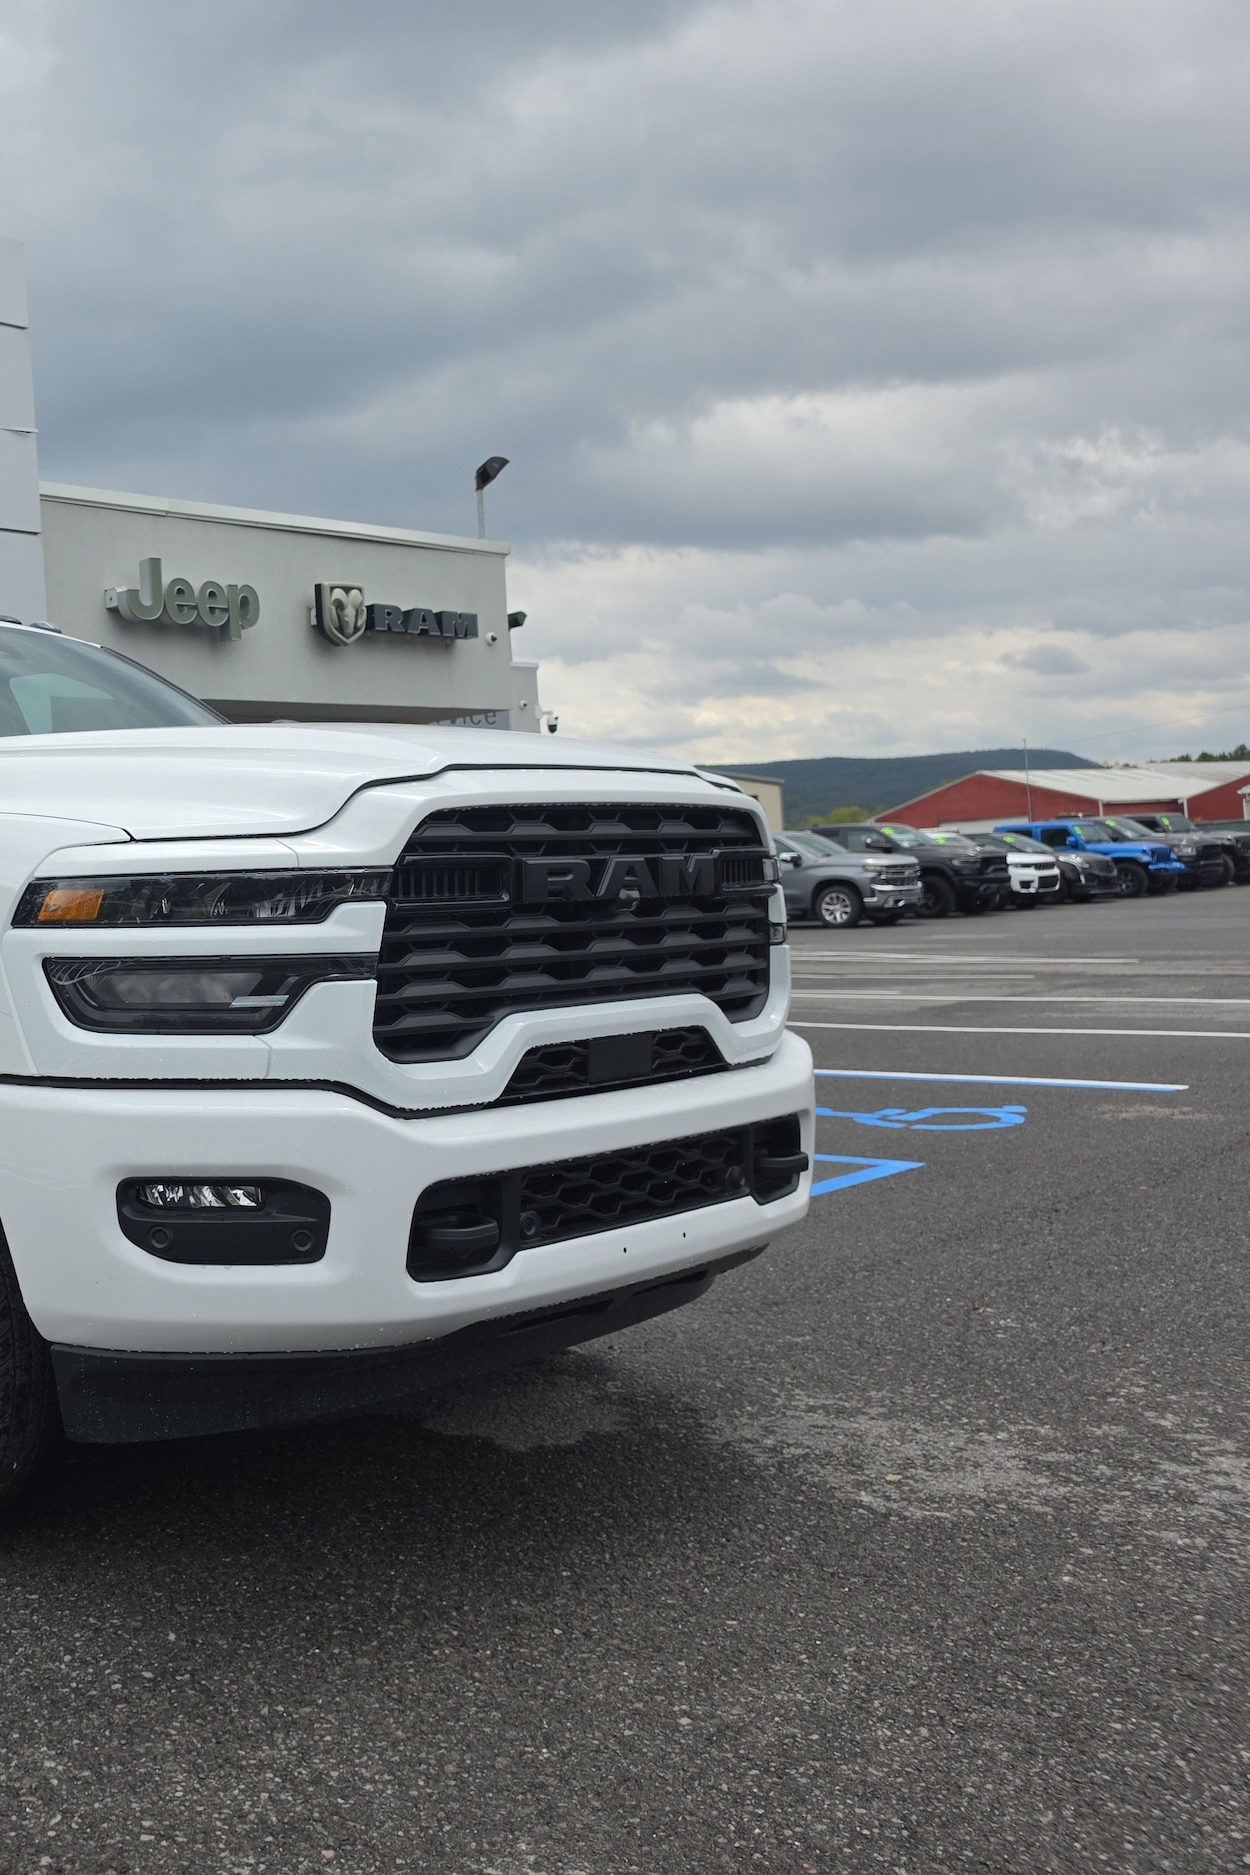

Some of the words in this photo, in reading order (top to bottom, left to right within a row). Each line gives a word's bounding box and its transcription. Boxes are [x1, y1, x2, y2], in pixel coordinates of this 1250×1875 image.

[117, 557, 260, 641] Jeep
[368, 603, 479, 640] RAM
[522, 854, 714, 899] RAM
